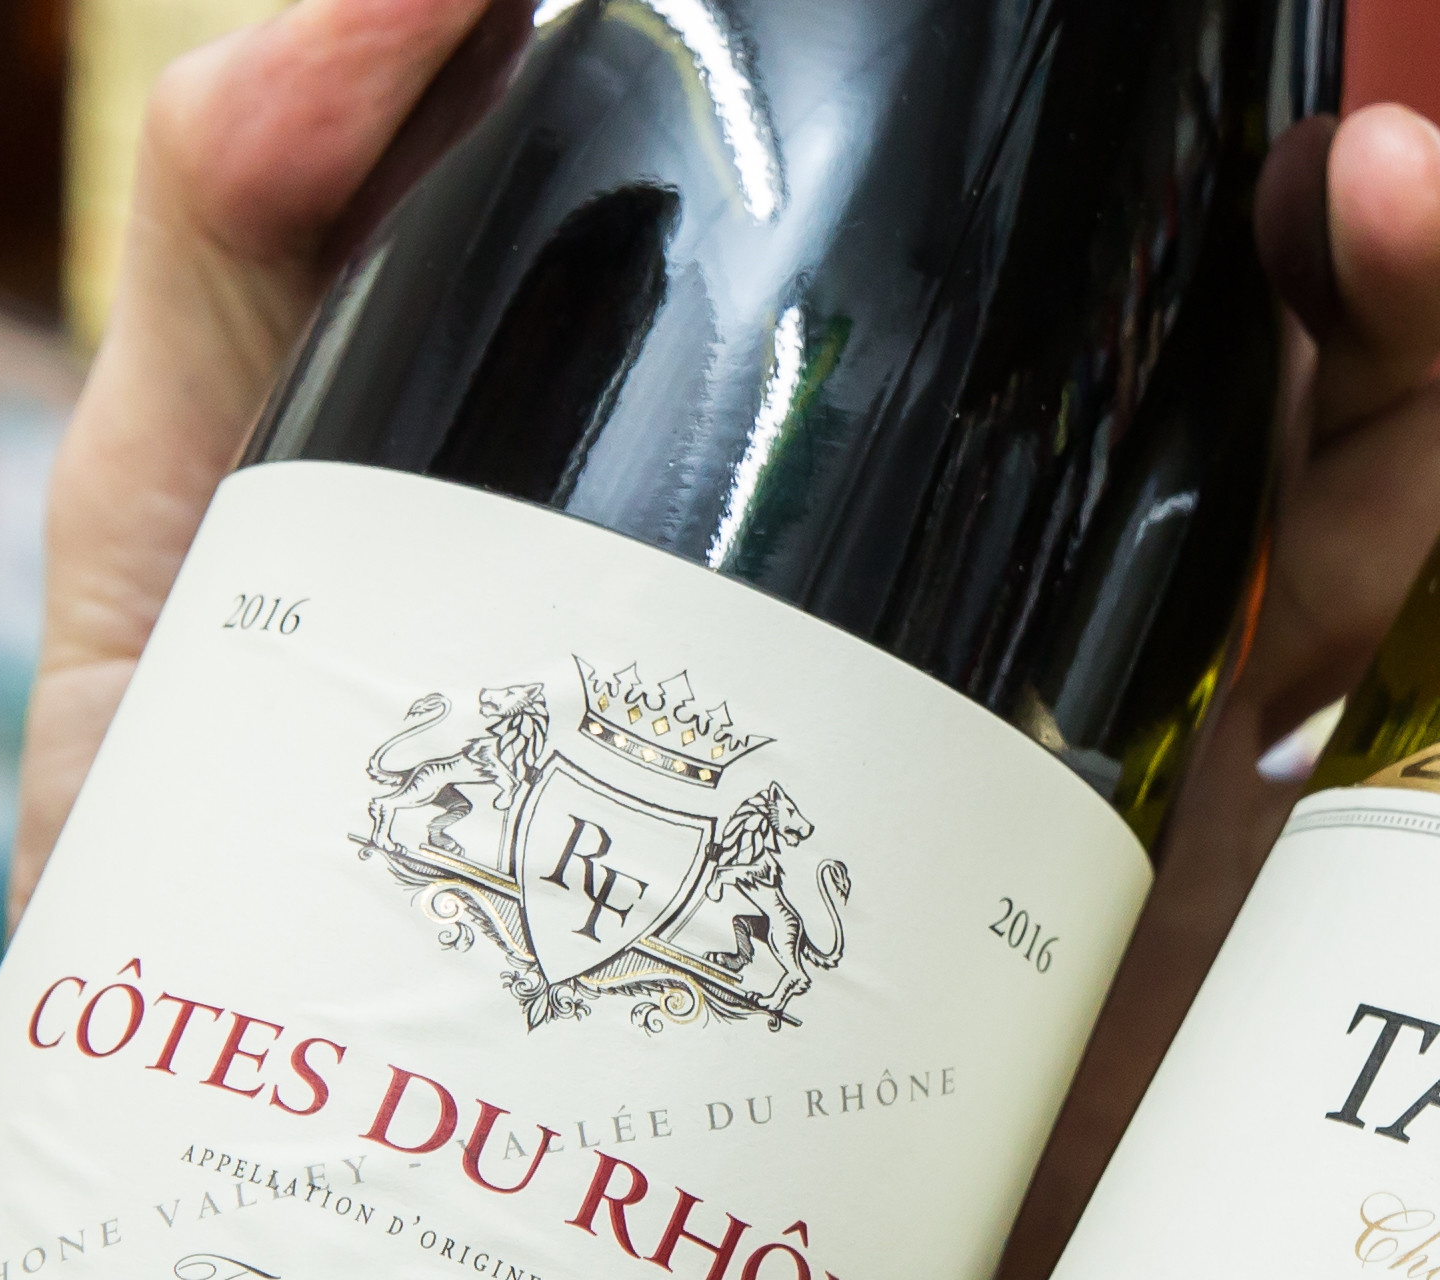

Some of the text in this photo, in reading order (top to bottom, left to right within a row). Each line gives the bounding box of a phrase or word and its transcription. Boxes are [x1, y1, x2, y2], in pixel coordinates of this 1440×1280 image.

[222, 593, 310, 636] 2016
[987, 895, 1062, 976] 2016
[26, 957, 348, 1117] CÔTES
[358, 1063, 562, 1196] DU
[154, 1154, 372, 1230] VALLEY
[705, 1093, 776, 1133] DU
[804, 1066, 957, 1120] RHÔNE
[180, 1144, 376, 1225] APPELLATION
